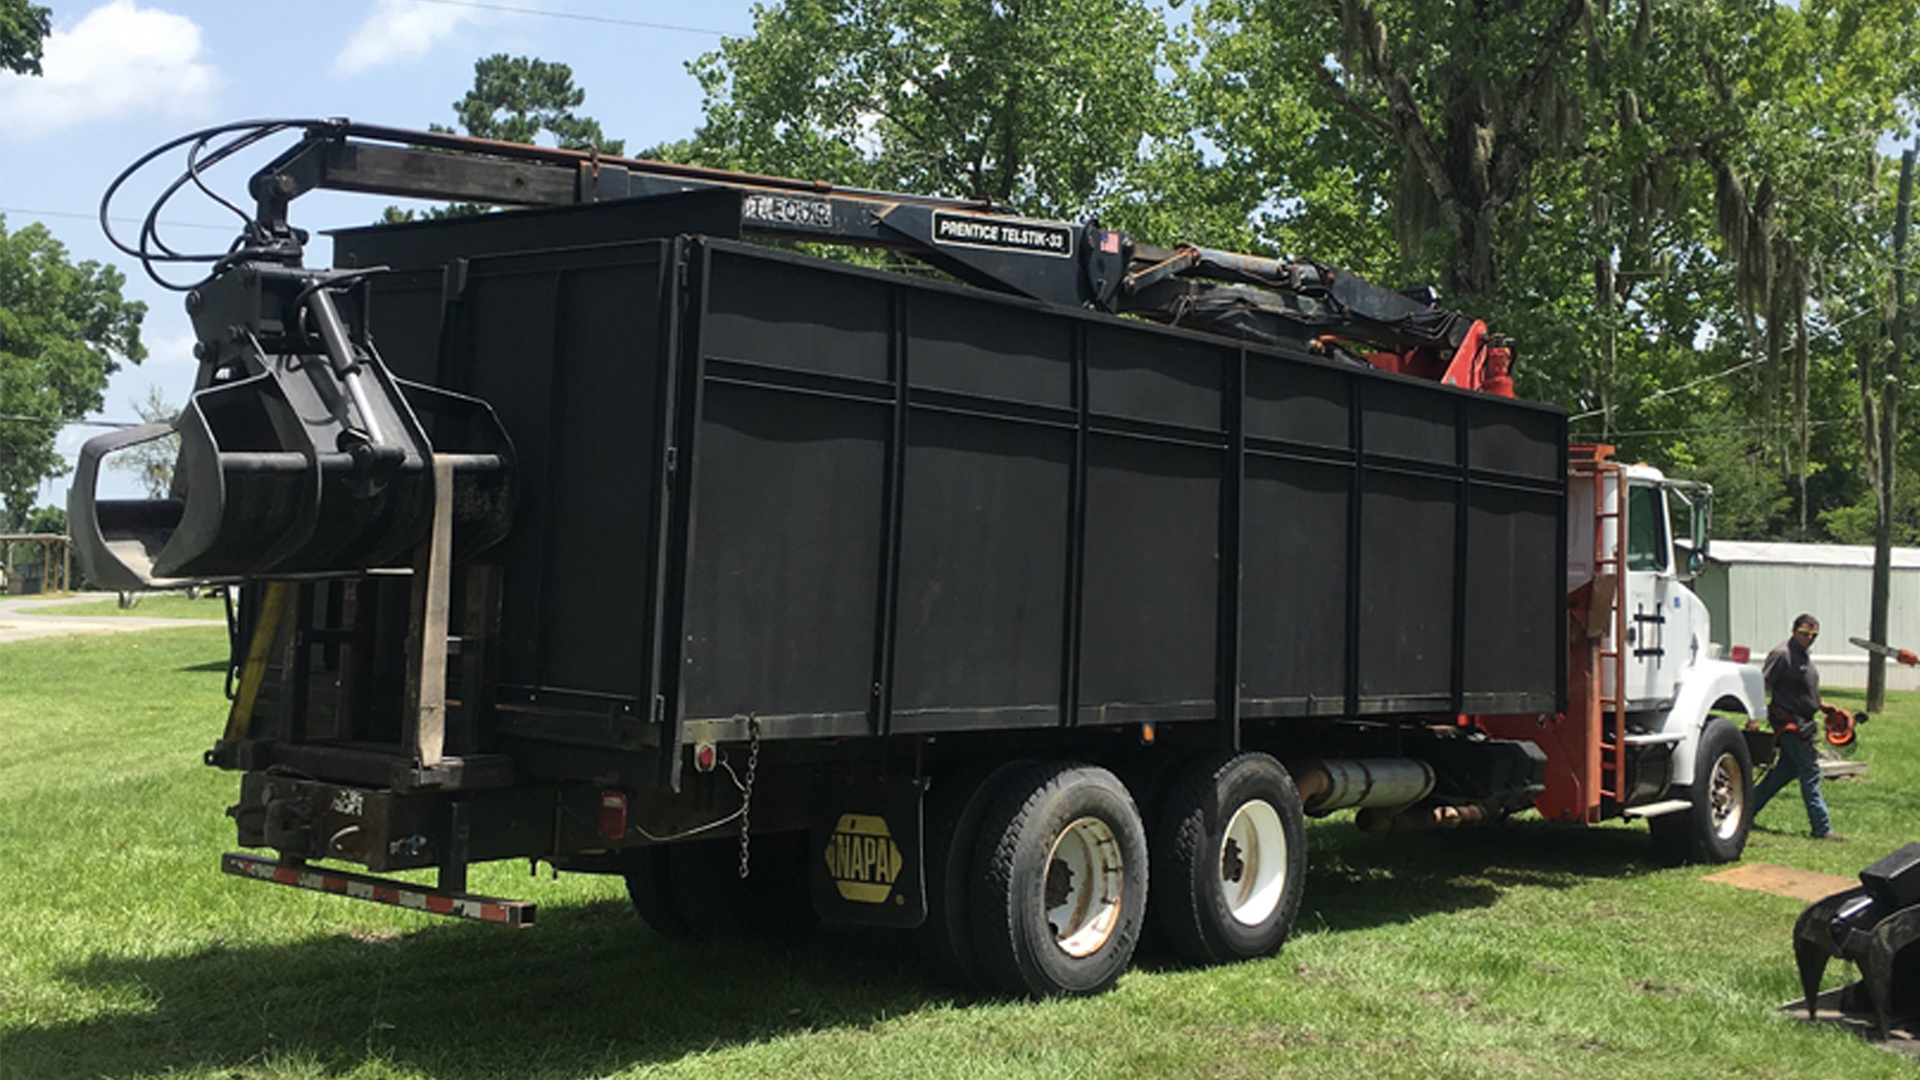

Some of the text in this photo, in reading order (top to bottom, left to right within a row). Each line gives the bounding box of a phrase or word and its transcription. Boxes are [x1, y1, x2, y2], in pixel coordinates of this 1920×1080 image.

[940, 220, 1064, 249] PRENTICE TELSTIK-33
[836, 834, 893, 884] NAPA
